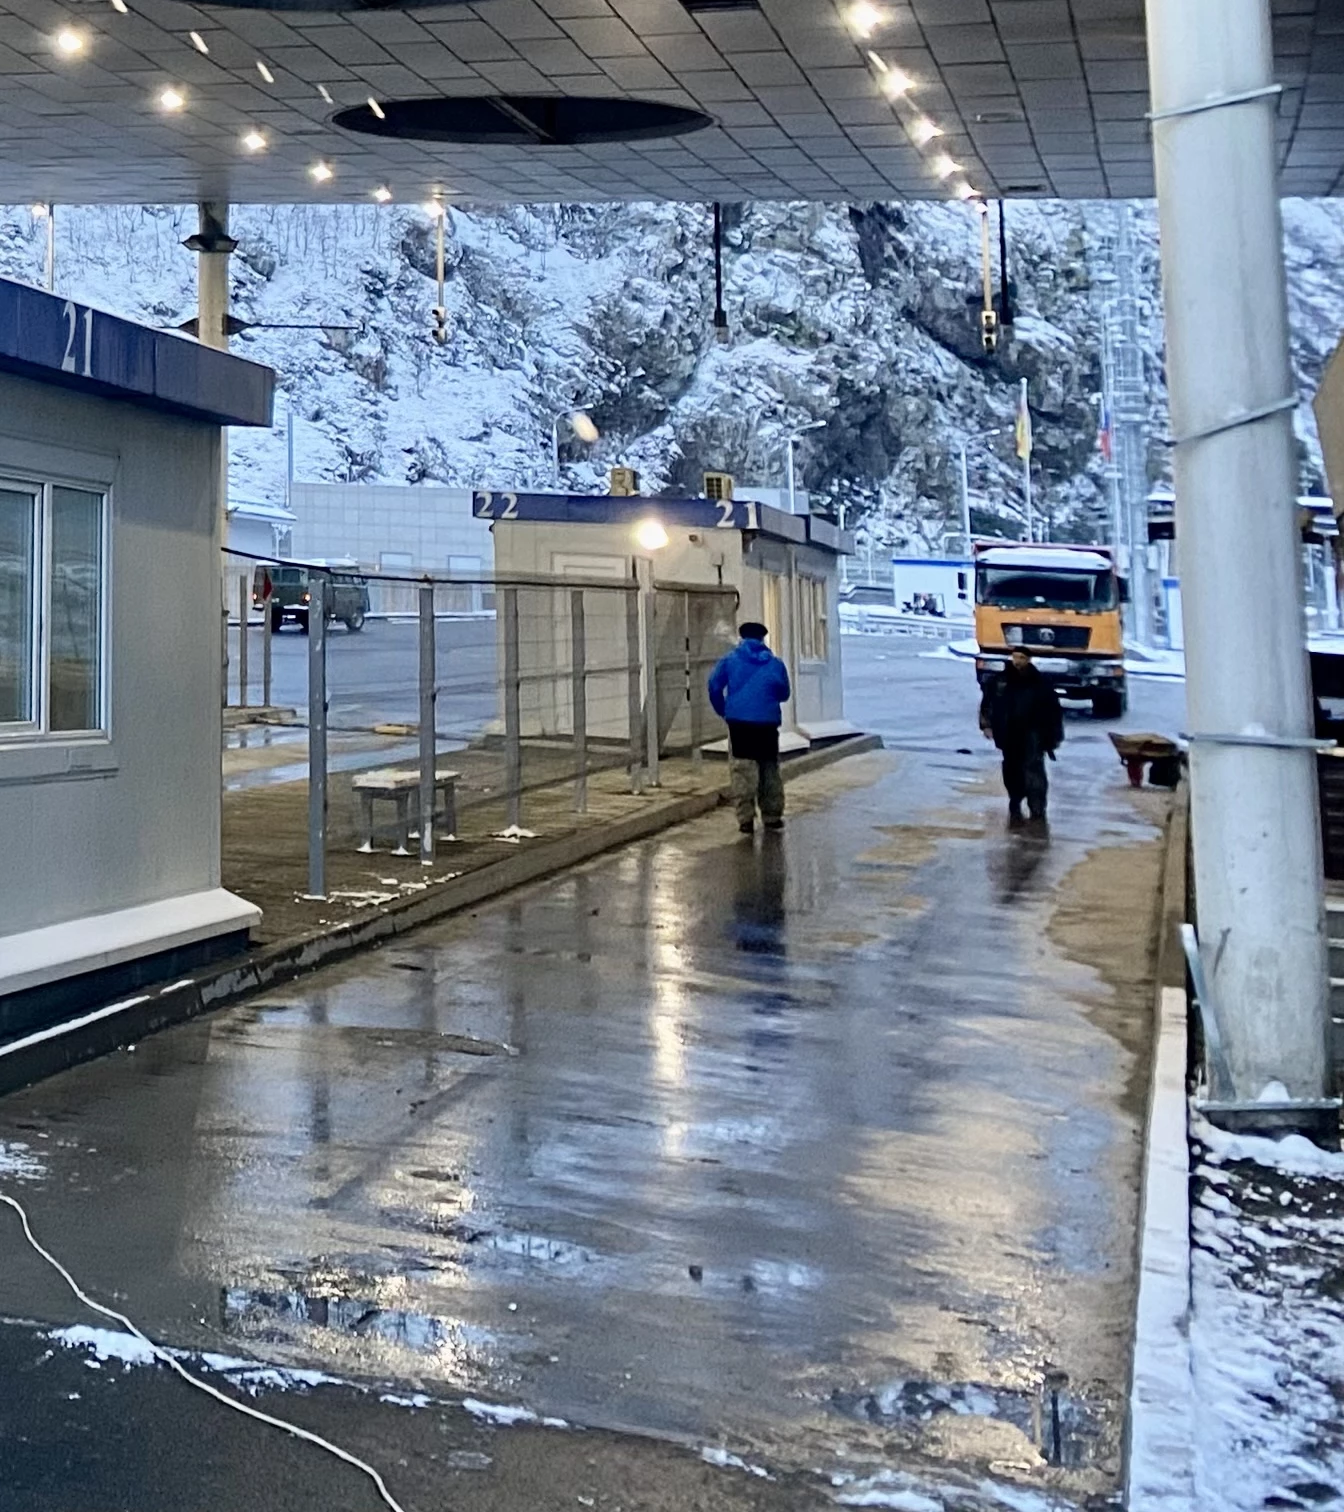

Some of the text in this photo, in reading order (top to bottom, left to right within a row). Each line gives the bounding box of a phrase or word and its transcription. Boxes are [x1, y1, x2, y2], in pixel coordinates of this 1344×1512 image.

[61, 301, 93, 377] 21
[476, 492, 519, 519] 22
[716, 500, 760, 529] 21
